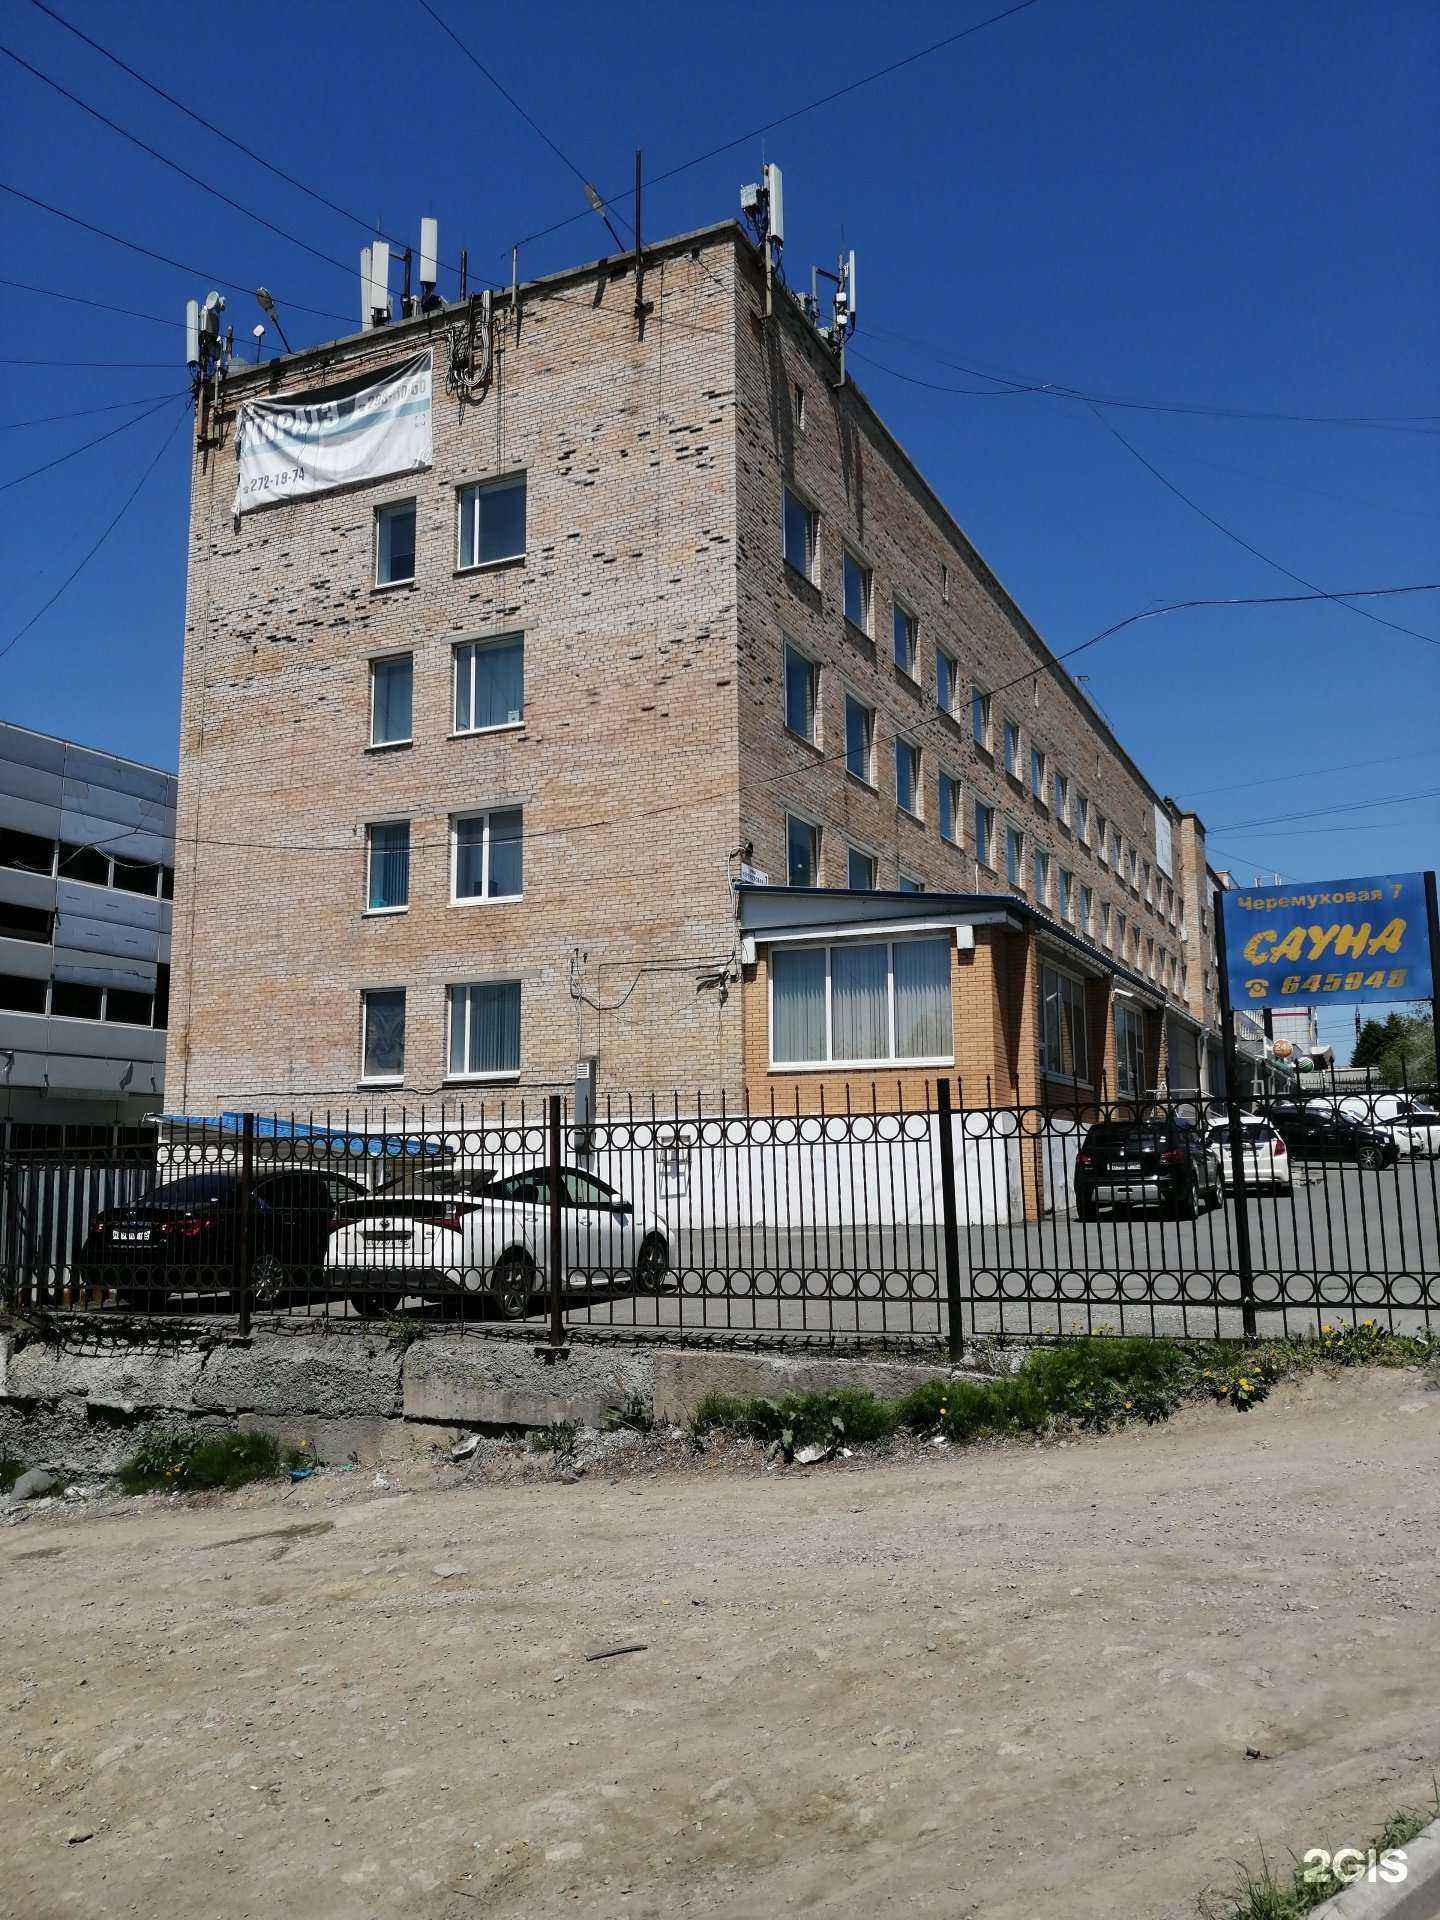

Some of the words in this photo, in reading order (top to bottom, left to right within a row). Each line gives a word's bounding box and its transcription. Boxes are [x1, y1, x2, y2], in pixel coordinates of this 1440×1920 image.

[250, 466, 305, 492] 272-18-74
[1238, 890, 1383, 912] Черемуховая
[1391, 884, 1403, 899] 7
[1243, 917, 1407, 966] САУНА
